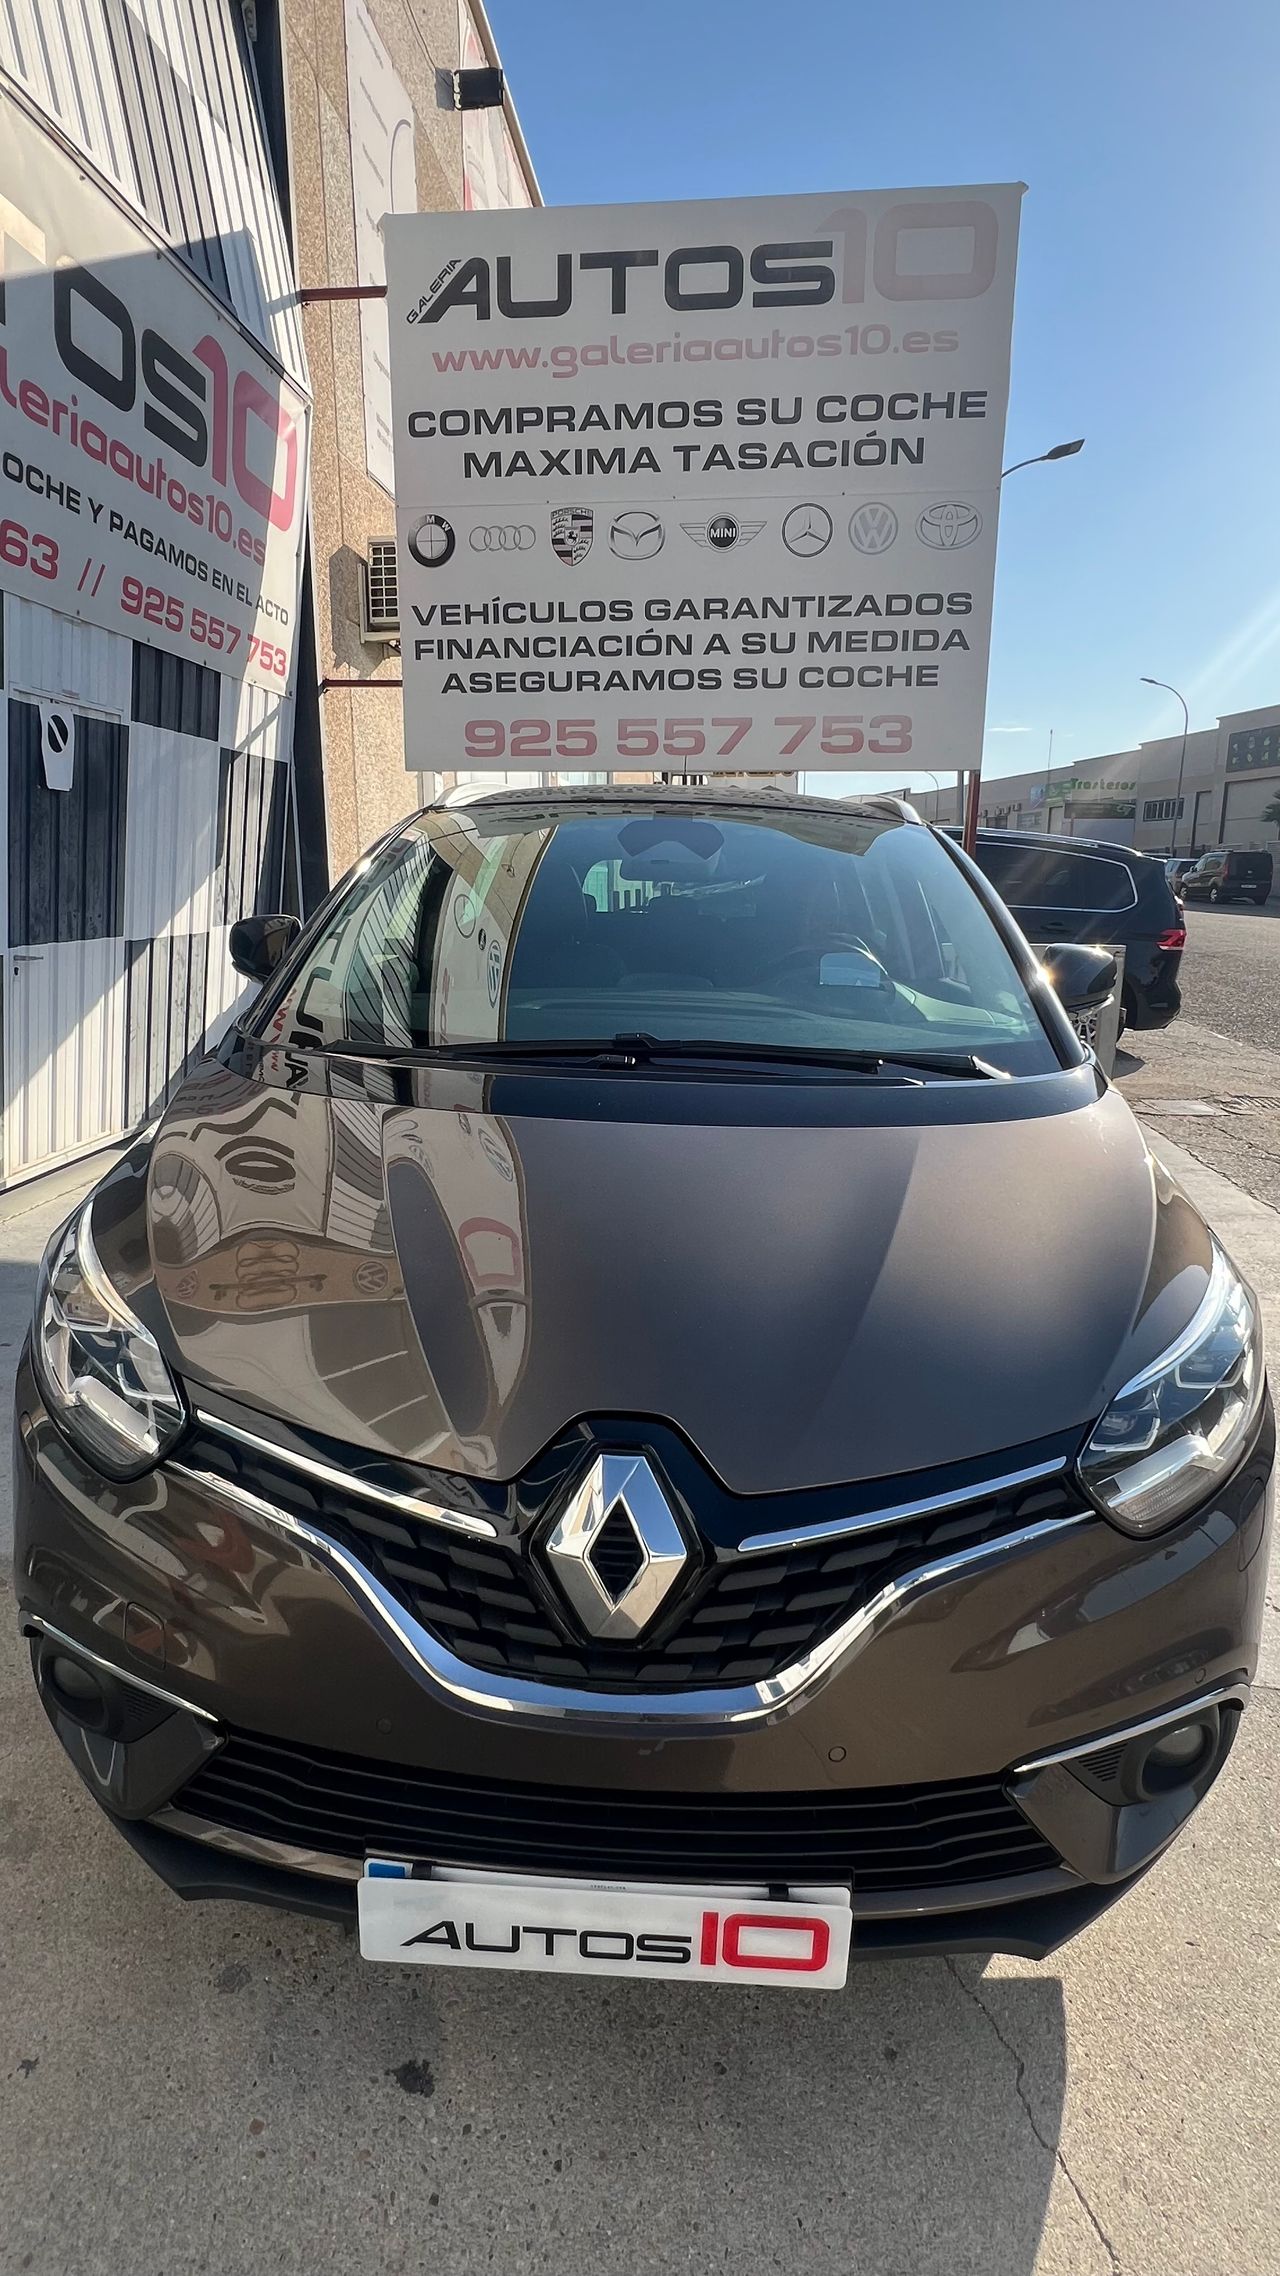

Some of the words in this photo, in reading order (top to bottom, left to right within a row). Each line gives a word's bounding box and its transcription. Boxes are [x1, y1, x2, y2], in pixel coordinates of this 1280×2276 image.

[406, 259, 461, 324] GALERIA
[432, 325, 959, 378] www.galeriaautos10.es
[408, 400, 723, 438] COMPRAMOS
[737, 397, 802, 426] SU
[816, 391, 988, 424] COCHE
[463, 446, 661, 479] MAXIMA
[673, 430, 925, 472] TASACIÓN
[3, 451, 81, 515] OCHE
[87, 496, 104, 524] Y
[110, 510, 209, 582] PAGAMOS
[212, 567, 234, 597] EN
[236, 585, 253, 608] EL
[256, 593, 289, 627] ACTO
[709, 527, 737, 540] MINI
[0, 519, 59, 580] 63
[120, 575, 185, 633] 925
[190, 607, 241, 655] 557
[247, 632, 287, 677] 753
[411, 596, 634, 627] VEHÍCULOS
[644, 592, 973, 622] GARANTIZADOS
[414, 628, 693, 661] FINANCIACIÓN
[702, 633, 731, 656] A
[741, 631, 796, 655] SU
[807, 628, 971, 654] MEDIDA
[441, 668, 722, 694] ASEGURAMOS
[733, 667, 787, 690] SU
[798, 664, 940, 689] COCHE
[464, 718, 598, 758] 925
[616, 717, 753, 757] 557
[774, 715, 914, 755] 753
